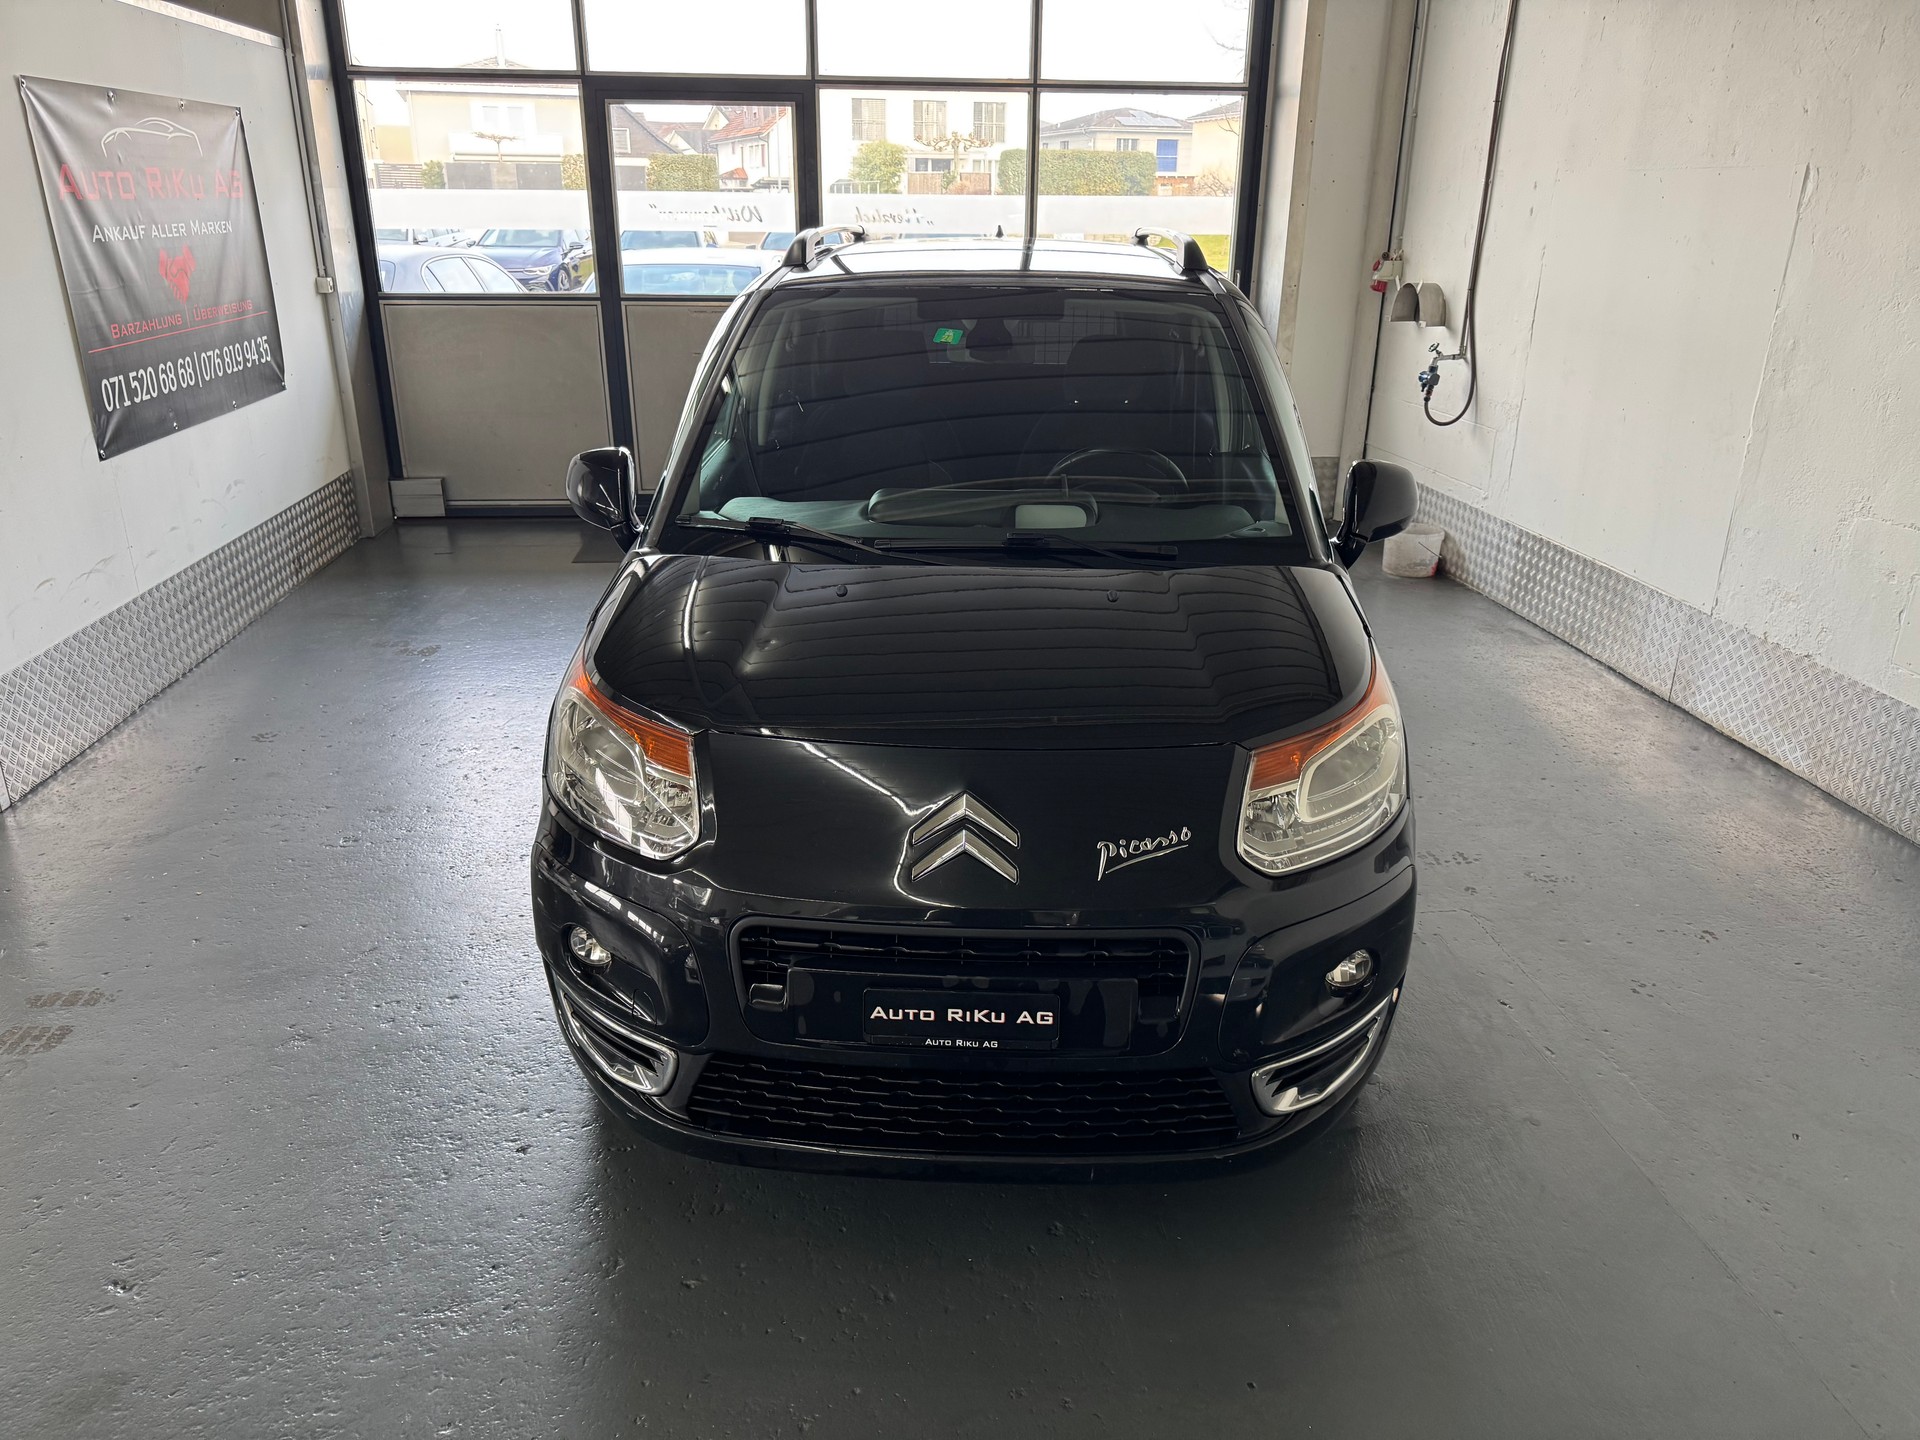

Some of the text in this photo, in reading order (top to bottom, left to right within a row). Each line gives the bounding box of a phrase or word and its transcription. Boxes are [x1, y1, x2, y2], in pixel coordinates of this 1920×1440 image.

[214, 168, 245, 200] AG
[92, 219, 233, 243] ANKAUF ALLER MARKEN
[110, 300, 253, 339] BARZAHLUNG ÜBERWEISUNG
[101, 374, 132, 412] 071
[129, 366, 159, 403] 520
[158, 360, 177, 395] 68
[177, 356, 196, 389] 68
[200, 348, 224, 382] 076
[223, 342, 244, 375] 819
[244, 338, 259, 369] 94
[256, 335, 272, 364] 35
[870, 1006, 936, 1022] AUTO
[1015, 1010, 1054, 1026] AG
[925, 1038, 952, 1047] AUTO
[982, 1040, 998, 1049] AG
